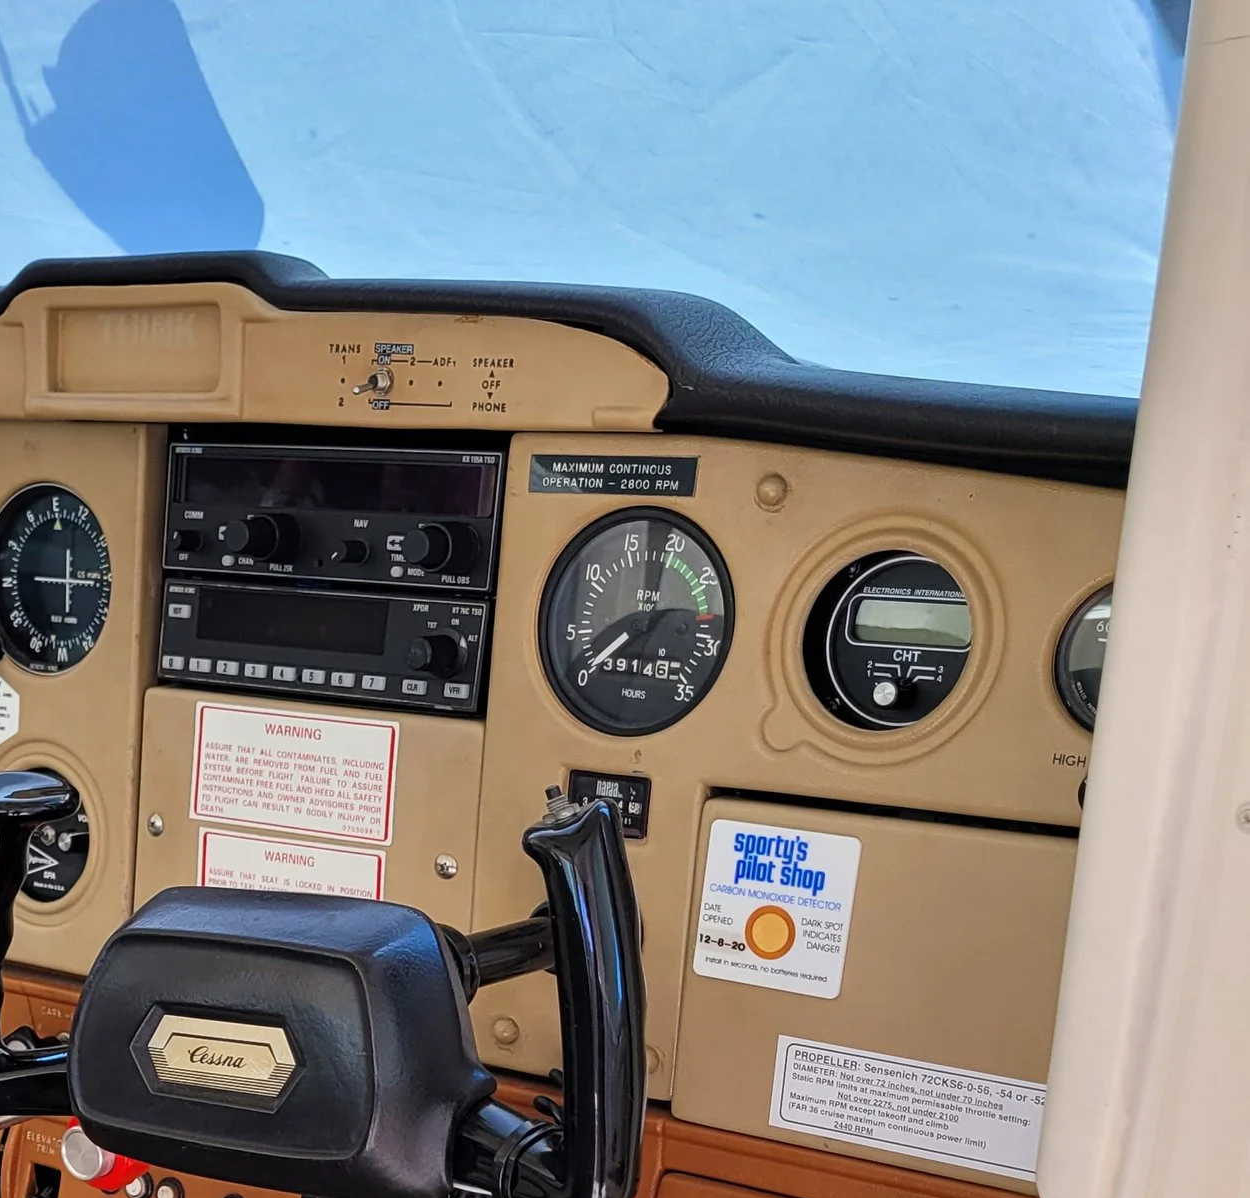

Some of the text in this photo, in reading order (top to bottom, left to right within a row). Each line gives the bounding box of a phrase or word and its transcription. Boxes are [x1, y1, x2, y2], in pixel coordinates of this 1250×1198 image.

[329, 344, 361, 353] TRANS
[376, 344, 413, 353] SPEAKER
[378, 356, 390, 364] ON
[473, 359, 514, 368] SPEAKER
[482, 381, 501, 389] OFF
[373, 401, 389, 409] OFF
[472, 403, 506, 412] PHONE
[552, 462, 672, 475] MAXIMUM CONTINOUS
[542, 478, 679, 490] OPERATION 2800 RPM
[354, 519, 368, 528] NAV
[624, 534, 638, 551] 15
[665, 534, 685, 551] 20
[441, 575, 455, 583] PULL
[586, 565, 600, 580] 10
[636, 590, 660, 601] RPM
[863, 587, 965, 597] ELECTRONICS INTERNATIONA
[893, 650, 921, 662] CHT
[621, 688, 646, 699] HOURS
[265, 723, 322, 740] WARNING
[205, 742, 232, 752] ASSURE
[237, 745, 255, 754] THAT
[260, 749, 272, 757] ALL
[342, 758, 384, 771] INCLUDING
[1052, 753, 1087, 768] HIGH
[235, 756, 248, 764] ARE
[253, 758, 289, 770] REMOVED
[294, 763, 315, 772] FROM
[320, 767, 338, 776] FUEL
[343, 770, 360, 778] AND
[365, 772, 383, 781] FUEL
[204, 763, 231, 773] SYSTEM
[237, 767, 263, 777] BEFORE
[301, 776, 331, 786] FAILURE
[352, 782, 382, 792] ASSURE
[203, 773, 382, 803] CONTAMINATE FREE FUEL AND HEED ALL SAFETY
[202, 784, 381, 815] INSTRUCTIONS AND OWNER ADVISORIES PRIOR
[202, 794, 211, 802] TO
[214, 795, 238, 806] FLIGHT
[242, 799, 258, 808] CAN
[262, 802, 290, 813] RESULT
[306, 808, 333, 819] BODILY
[337, 812, 365, 823] INJURY
[370, 817, 381, 825] OR
[734, 833, 809, 865] sporty's
[264, 850, 315, 867] WARNING
[209, 868, 233, 878] ASSURE
[239, 872, 256, 881] THAT
[261, 874, 278, 884] SEAT
[284, 878, 290, 886] IS
[295, 879, 322, 891] LOCKED
[327, 884, 334, 892] IN
[340, 886, 372, 898] POSITION
[734, 855, 826, 896] pilot shop
[710, 883, 841, 912] CARBON MONOXIDE DETECTOR
[704, 903, 721, 913] DATE
[703, 914, 733, 925] OPENED
[801, 918, 843, 930] DARK SPOT
[699, 934, 745, 951] 12-8-20
[803, 930, 842, 942] INDICATES
[807, 942, 840, 953] DANGER
[771, 967, 798, 978] batteries
[800, 972, 828, 983] required
[188, 1046, 246, 1068] Cessna
[794, 1050, 861, 1071] PROPELLER:
[864, 1063, 918, 1082] Sensenich
[996, 1087, 1012, 1100] -54
[1015, 1093, 1028, 1102] or
[793, 1062, 838, 1078] DIAMETER:
[840, 1071, 855, 1082] Not
[857, 1076, 873, 1085] over
[876, 1078, 886, 1087] 72
[920, 1087, 933, 1096] not
[936, 1090, 960, 1102] under
[962, 1094, 973, 1104] 70
[975, 1096, 1003, 1111] inches
[791, 1072, 1031, 1127] Static RPM limits at maximum permissable throttle setting:
[837, 1091, 959, 1123] Not over 2275, not under 2100
[790, 1091, 949, 1131] Maximum RPM except takeoff and climb
[788, 1102, 987, 1150] (FAR 36 cruise maximum continuous power limit)
[834, 1120, 874, 1136] 2440 RPM
